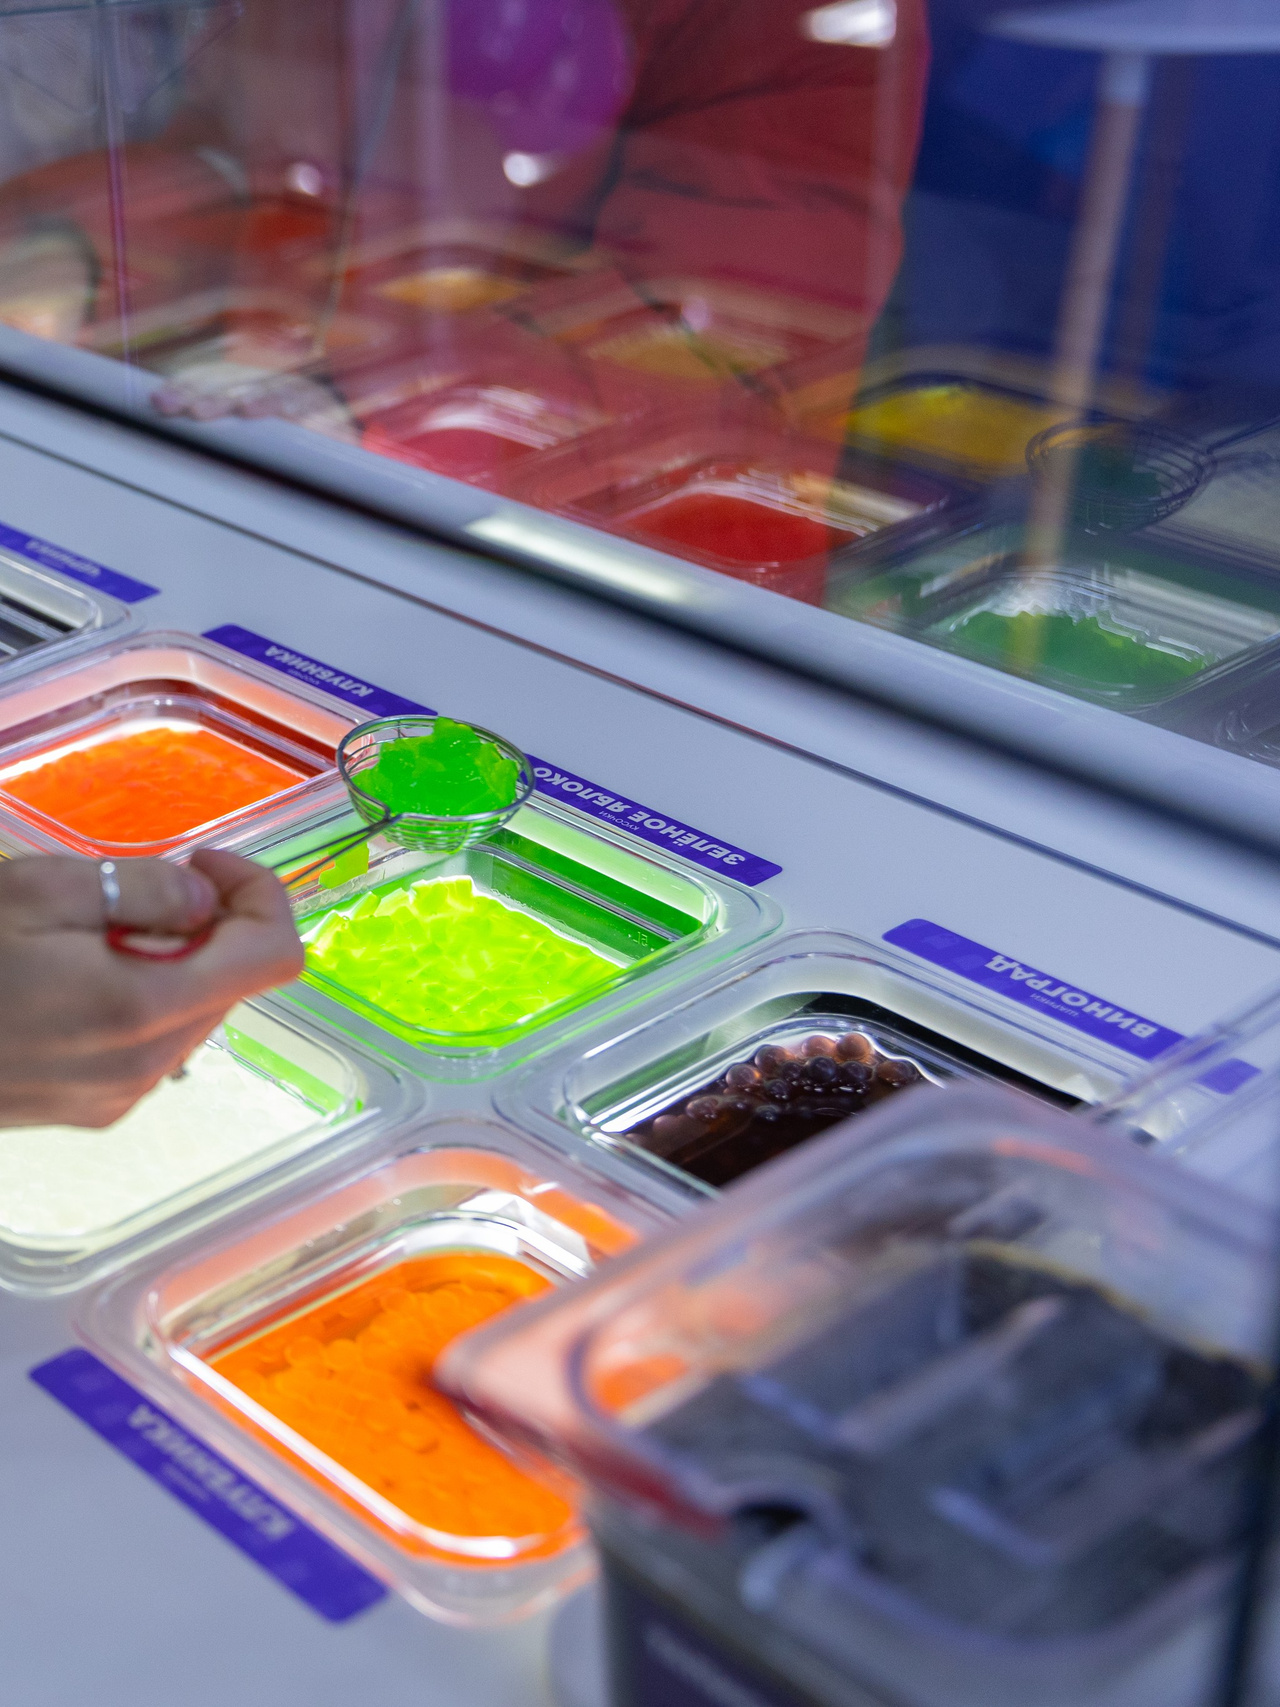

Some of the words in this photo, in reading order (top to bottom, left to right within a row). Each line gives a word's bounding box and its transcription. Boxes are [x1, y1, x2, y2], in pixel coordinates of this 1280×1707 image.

[263, 644, 375, 699] КЛУБНИКА
[534, 764, 632, 816] ЯБЛОКО
[598, 809, 640, 833] КУСОЧКИ
[627, 806, 746, 866] ЗЕЛЁНОЕ
[984, 954, 1158, 1039] ВИНОГРАД
[1030, 992, 1080, 1018] ШАРИКИ
